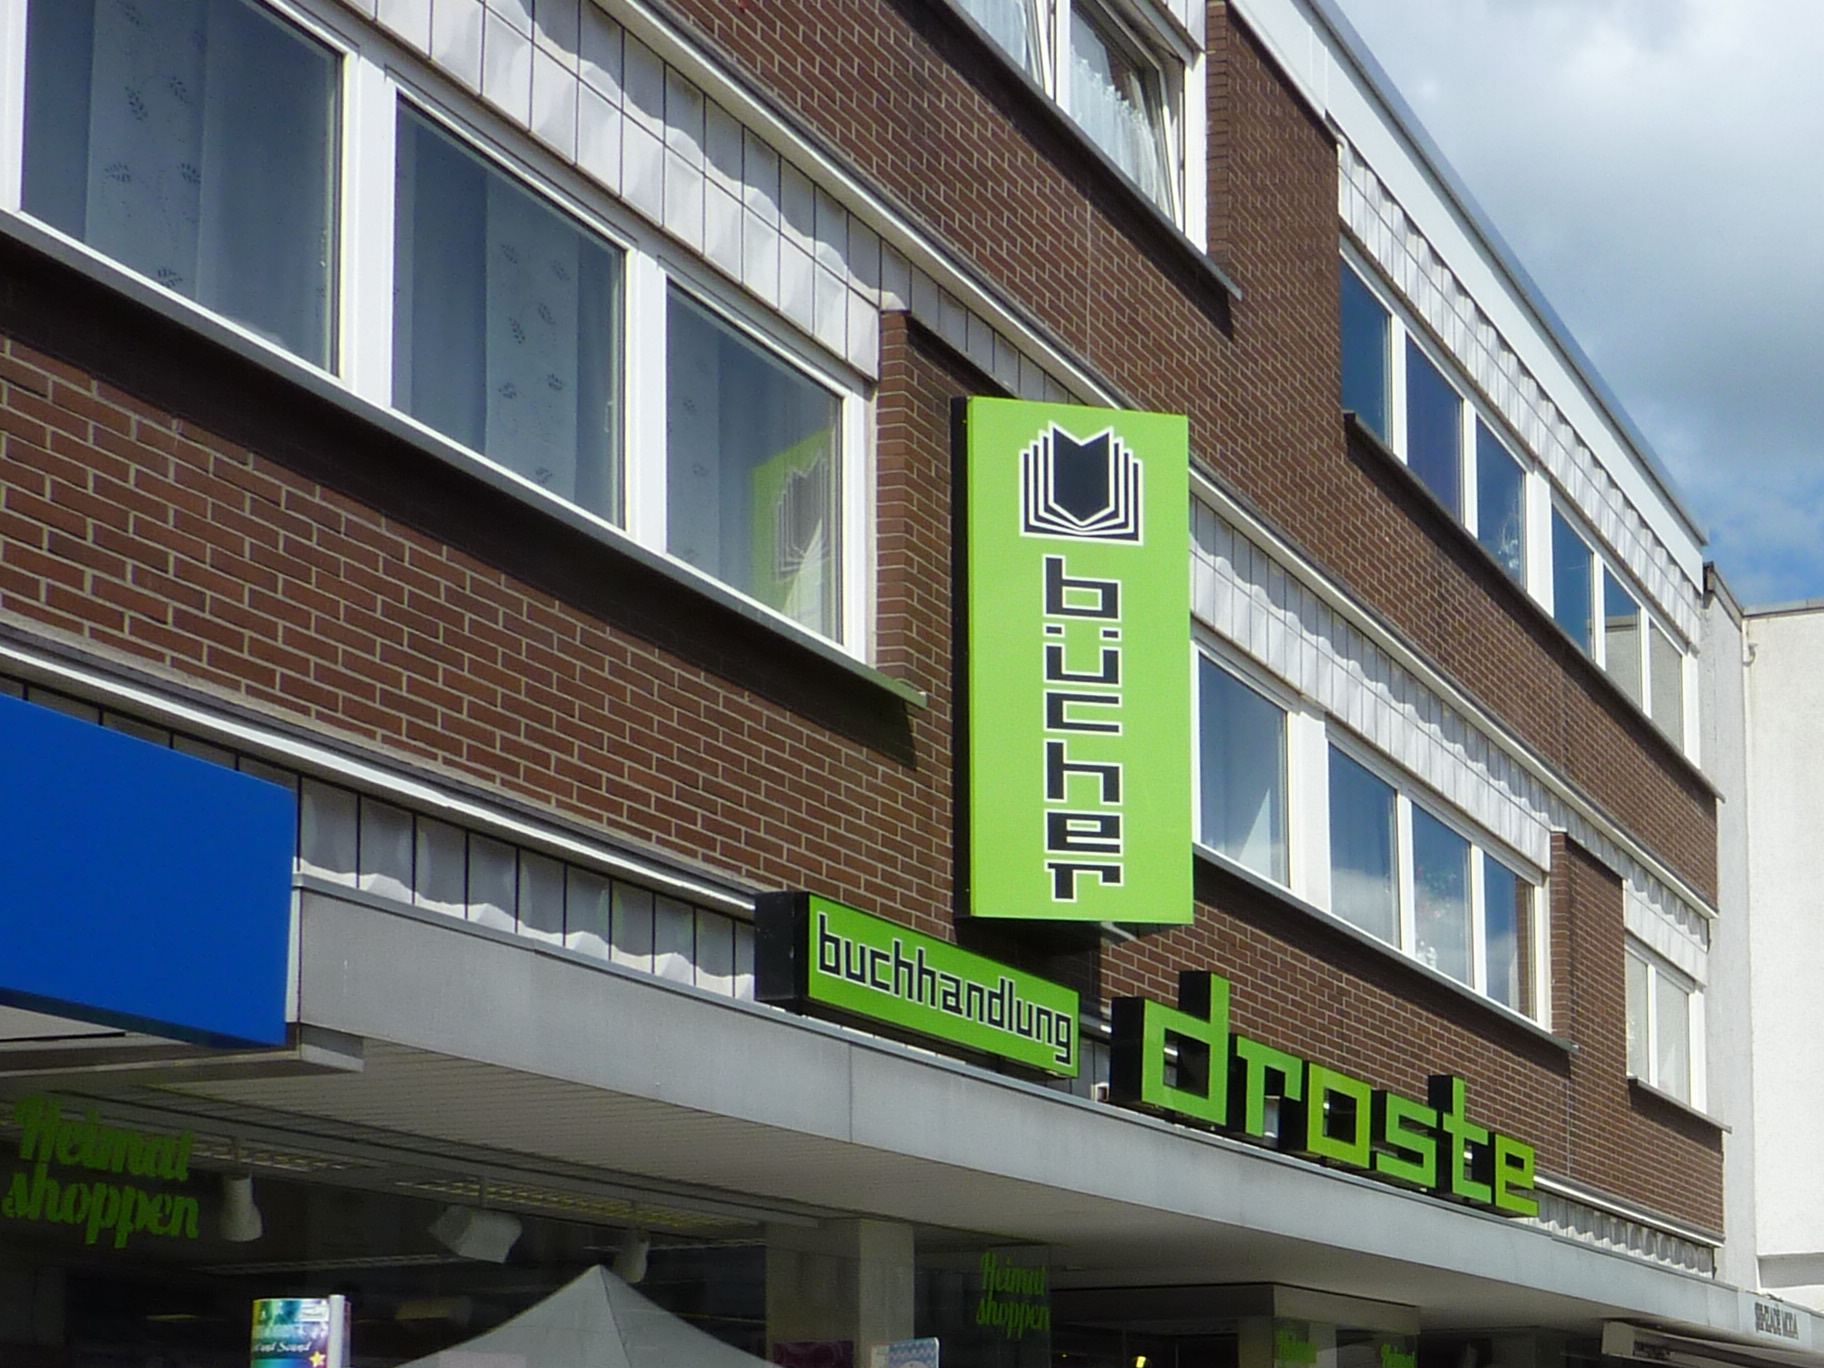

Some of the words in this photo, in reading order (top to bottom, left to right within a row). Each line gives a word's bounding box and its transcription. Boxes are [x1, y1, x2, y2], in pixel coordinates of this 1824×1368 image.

[1042, 554, 1124, 903] bücher
[817, 911, 1074, 1068] buchhandlung
[1140, 971, 1540, 1219] droste
[2, 1161, 200, 1249] shoppen
